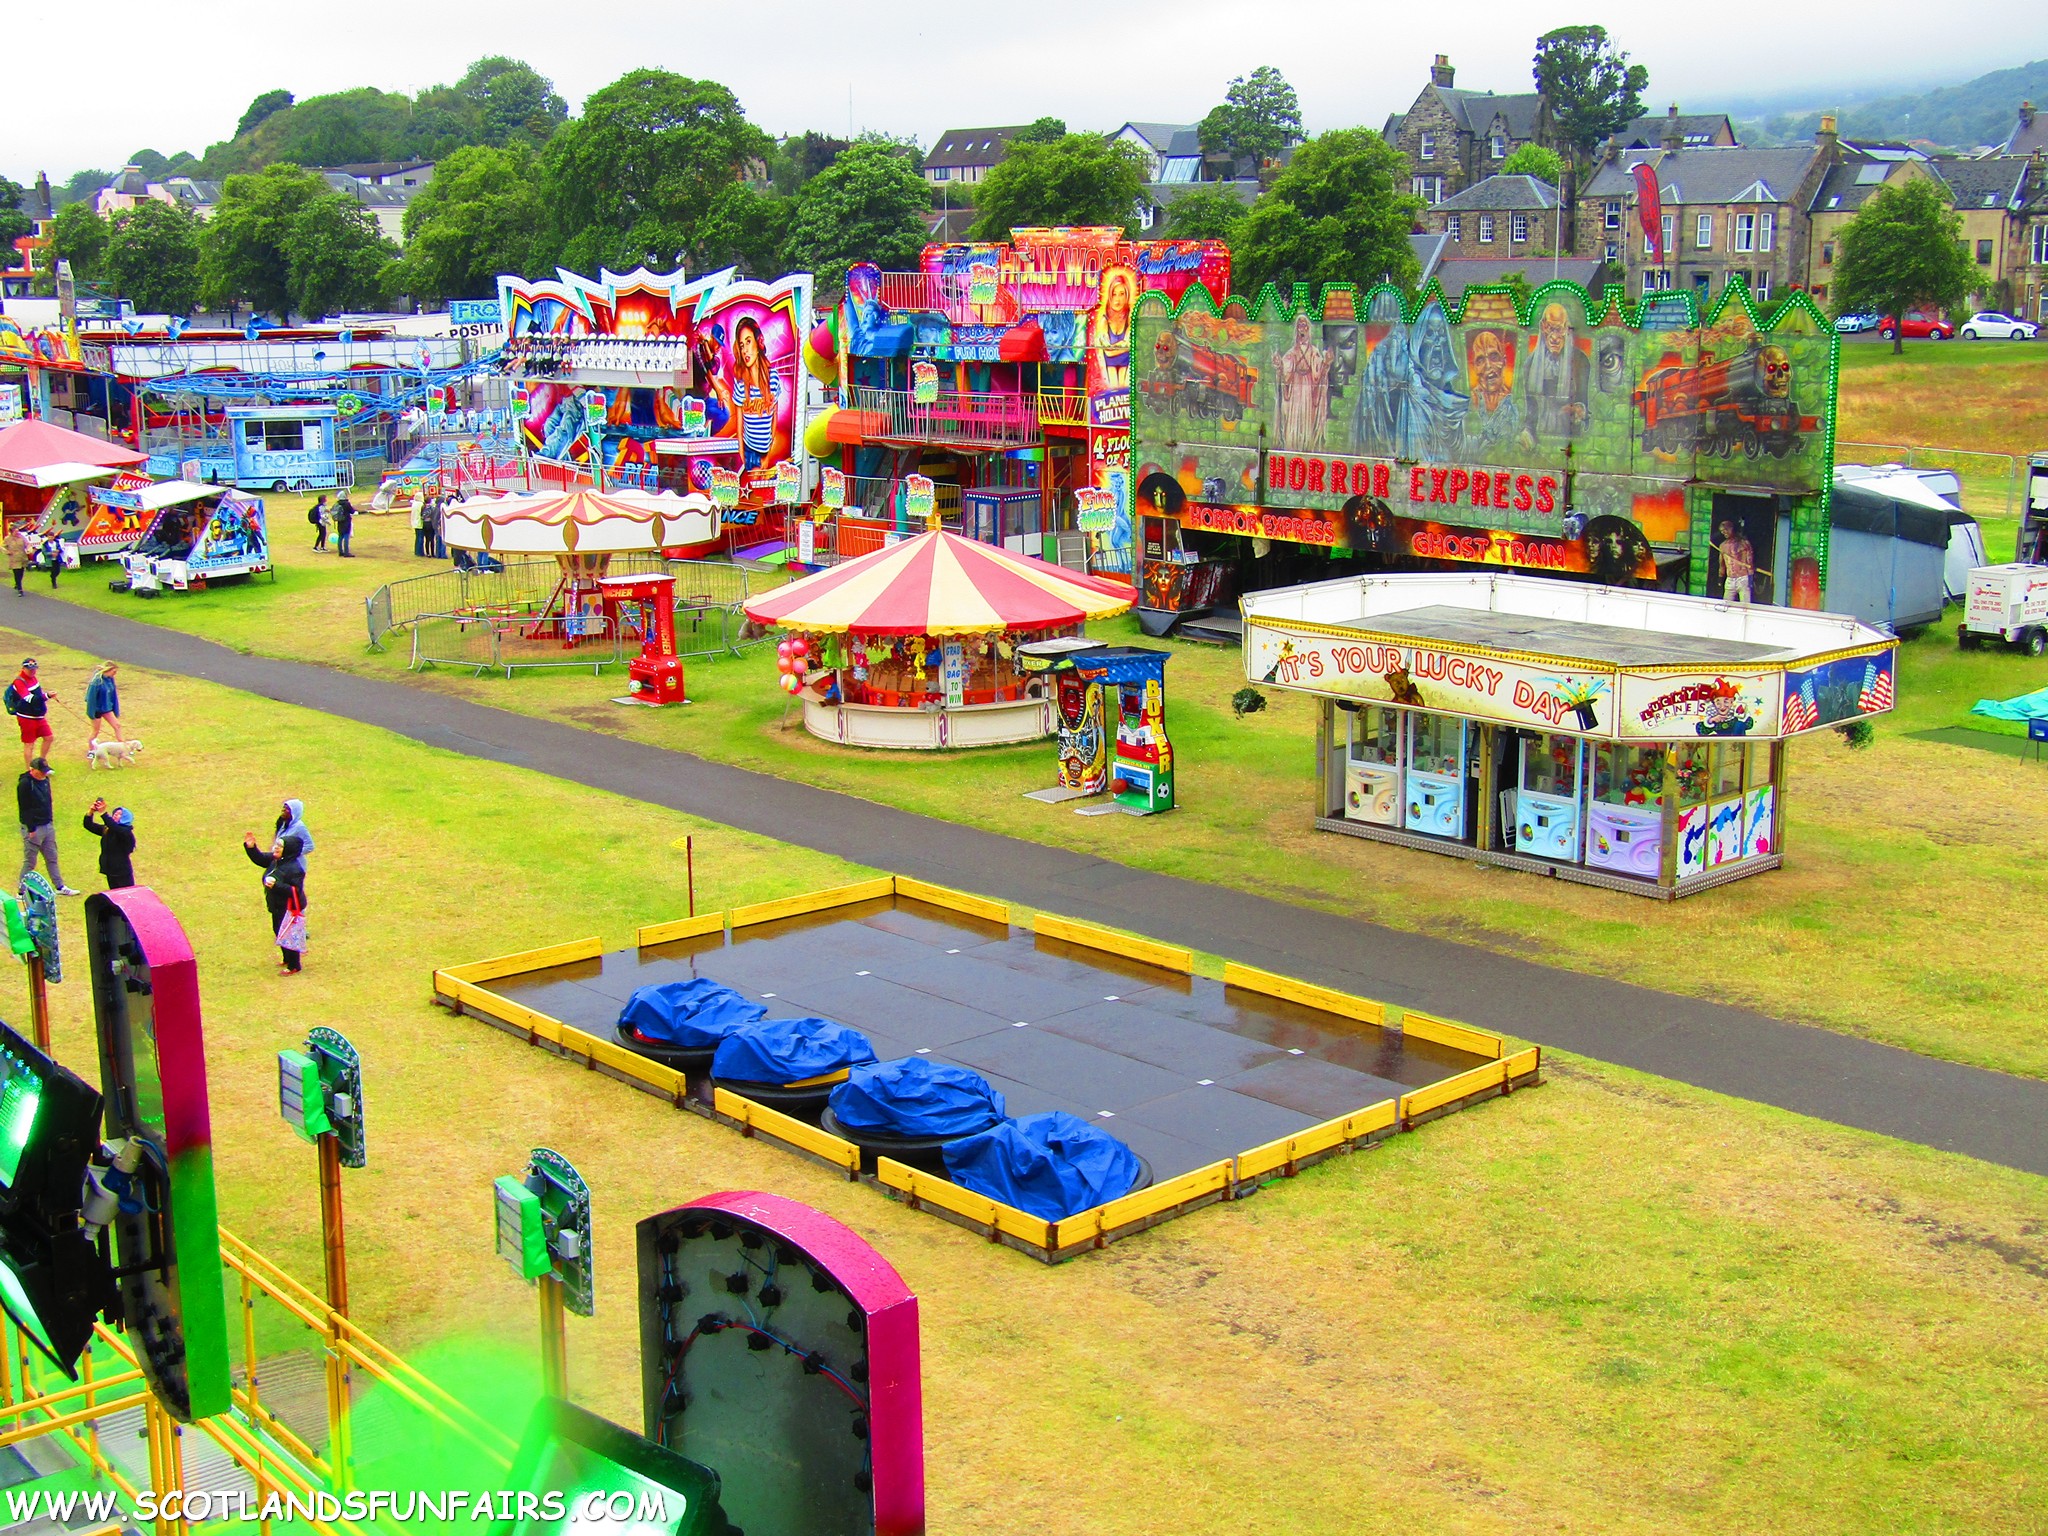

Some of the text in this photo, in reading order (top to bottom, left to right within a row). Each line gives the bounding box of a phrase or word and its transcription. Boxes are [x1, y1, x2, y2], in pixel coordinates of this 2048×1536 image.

[449, 324, 503, 338] POSITI
[954, 346, 1000, 360] FUN HOU
[1094, 394, 1131, 418] PLANE
[1099, 405, 1131, 424] HOLLYW
[1094, 434, 1131, 460] 4 FLOO
[1106, 453, 1121, 466] OF
[201, 462, 234, 474] FROZE
[1268, 455, 1557, 514] HORROR EXPRESS
[720, 510, 759, 525] NCE
[1189, 505, 1336, 544] HORROR EXPRESS
[1411, 531, 1567, 568] GHOST TRAIN
[946, 645, 961, 656] GRAB
[951, 659, 957, 668] A
[946, 670, 961, 679] BAG
[951, 682, 959, 692] TO
[1279, 647, 1572, 726] IT'S YOUR LUCKY DAY
[949, 693, 962, 704] WIN
[1647, 702, 1707, 728] CRANES
[1146, 680, 1171, 775] BOXER
